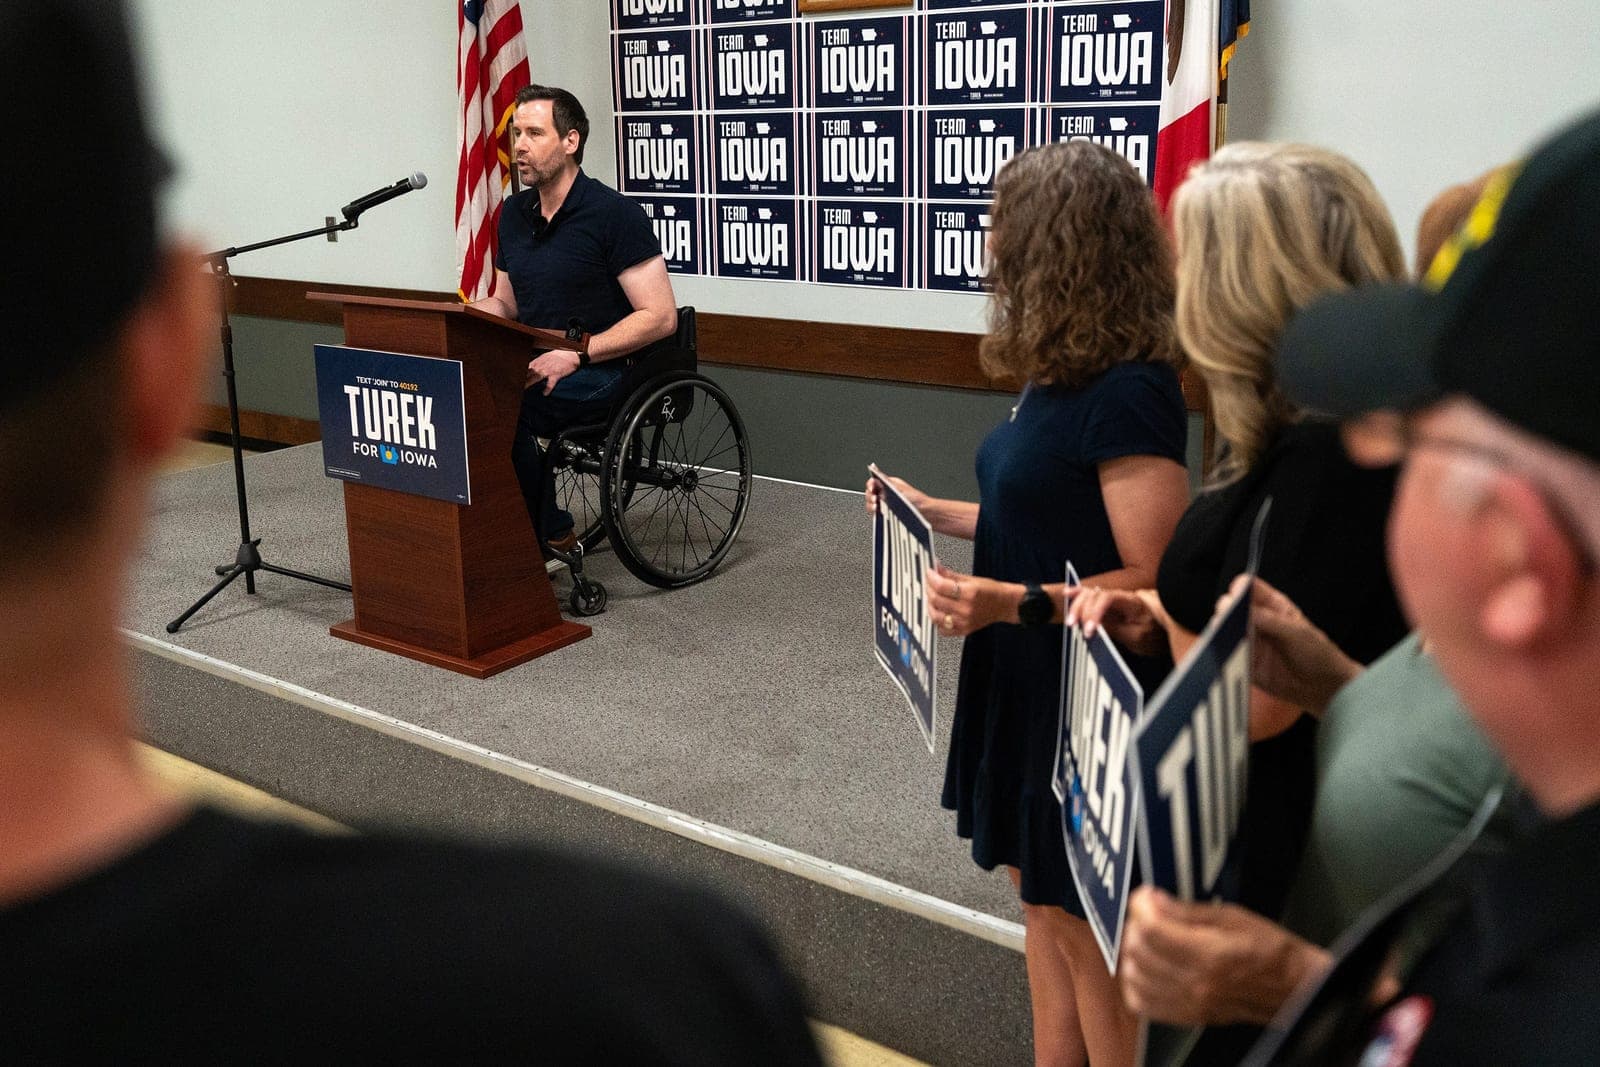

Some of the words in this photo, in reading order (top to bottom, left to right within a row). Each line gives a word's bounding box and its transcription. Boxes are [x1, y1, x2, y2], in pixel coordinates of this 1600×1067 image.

[936, 21, 967, 39] TEAM
[1062, 14, 1097, 33] TEAM
[718, 34, 744, 51] TEAM
[822, 28, 850, 46] TEAM
[624, 39, 648, 55] TEAM
[935, 37, 1017, 90] IOWA
[1060, 31, 1153, 86] IOWA
[624, 55, 686, 99] IOWA
[718, 49, 785, 97] IOWA
[821, 44, 895, 93] IOWA
[628, 122, 651, 138] TEAM
[720, 121, 746, 137] TEAM
[822, 119, 850, 136] TEAM
[935, 118, 966, 135] TEAM
[1060, 116, 1094, 134] TEAM
[628, 138, 689, 181] IOWA
[720, 137, 787, 182] IOWA
[822, 136, 895, 183] IOWA
[723, 205, 748, 221] TEAM
[824, 208, 851, 225] TEAM
[935, 211, 965, 229] TEAM
[722, 222, 788, 266] IOWA
[823, 225, 895, 273] IOWA
[934, 229, 988, 277] IOW
[356, 376, 372, 385] TEXT
[389, 380, 399, 389] TO
[343, 384, 437, 450] TUREK
[353, 441, 379, 458] FOR
[400, 449, 438, 469] IOWA
